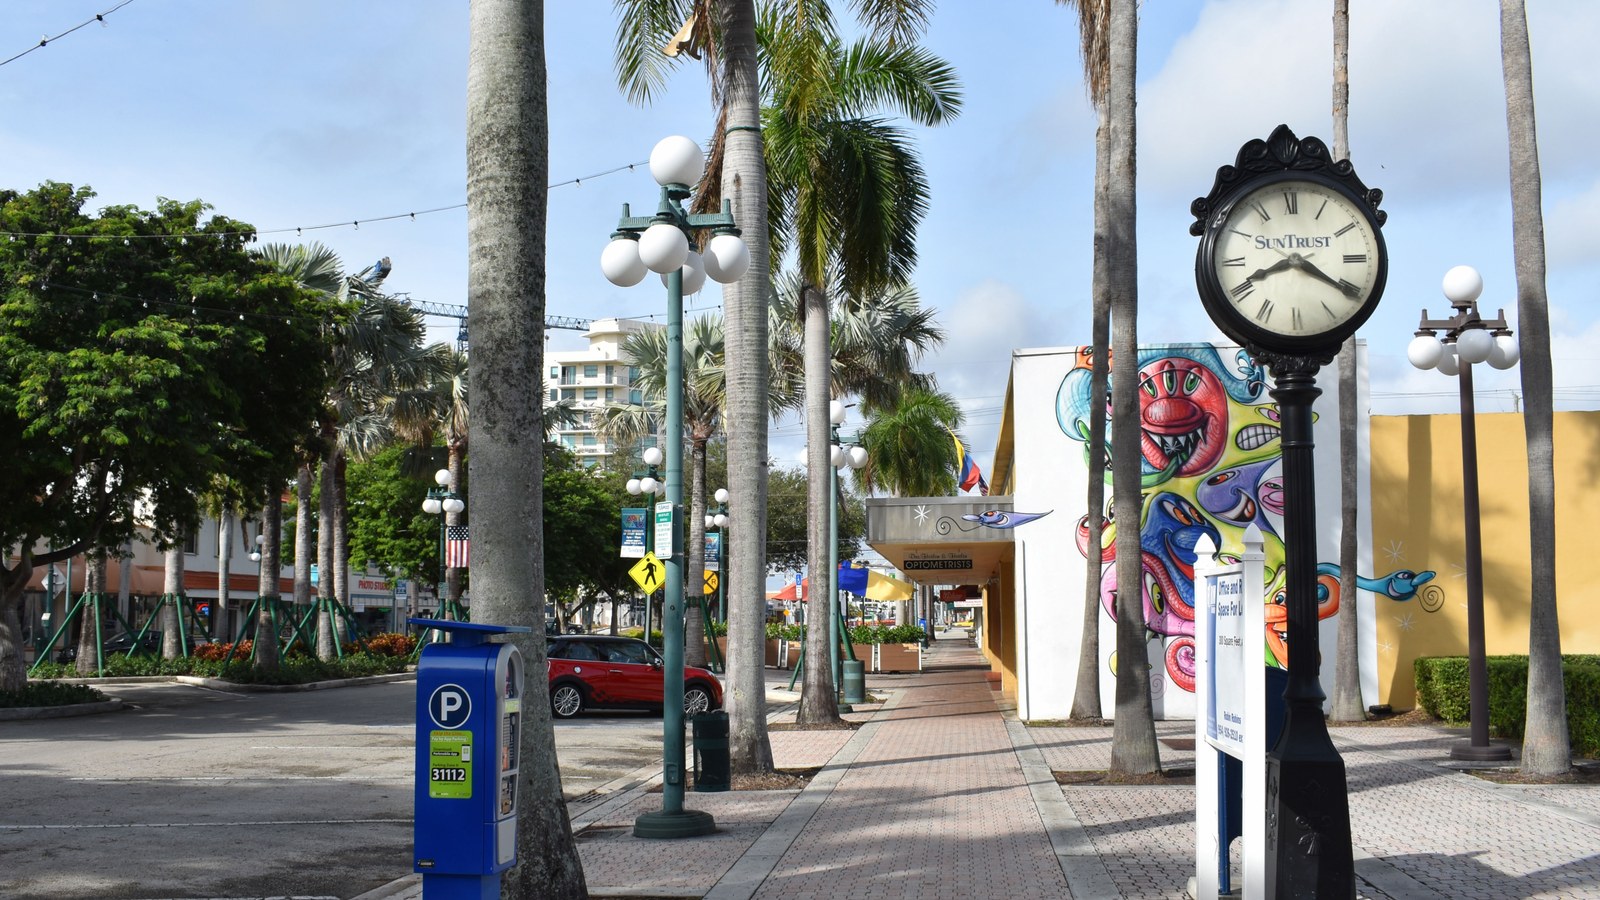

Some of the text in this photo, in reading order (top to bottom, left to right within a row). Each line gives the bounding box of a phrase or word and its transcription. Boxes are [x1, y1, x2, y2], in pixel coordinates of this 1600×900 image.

[905, 560, 971, 569] OPTOMETRISTS
[711, 578, 717, 586] R
[1219, 580, 1230, 596] Office
[1230, 579, 1238, 595] and
[1218, 603, 1230, 621] Space
[1230, 601, 1238, 617] For
[441, 691, 463, 721] P
[432, 768, 465, 781] 31112
